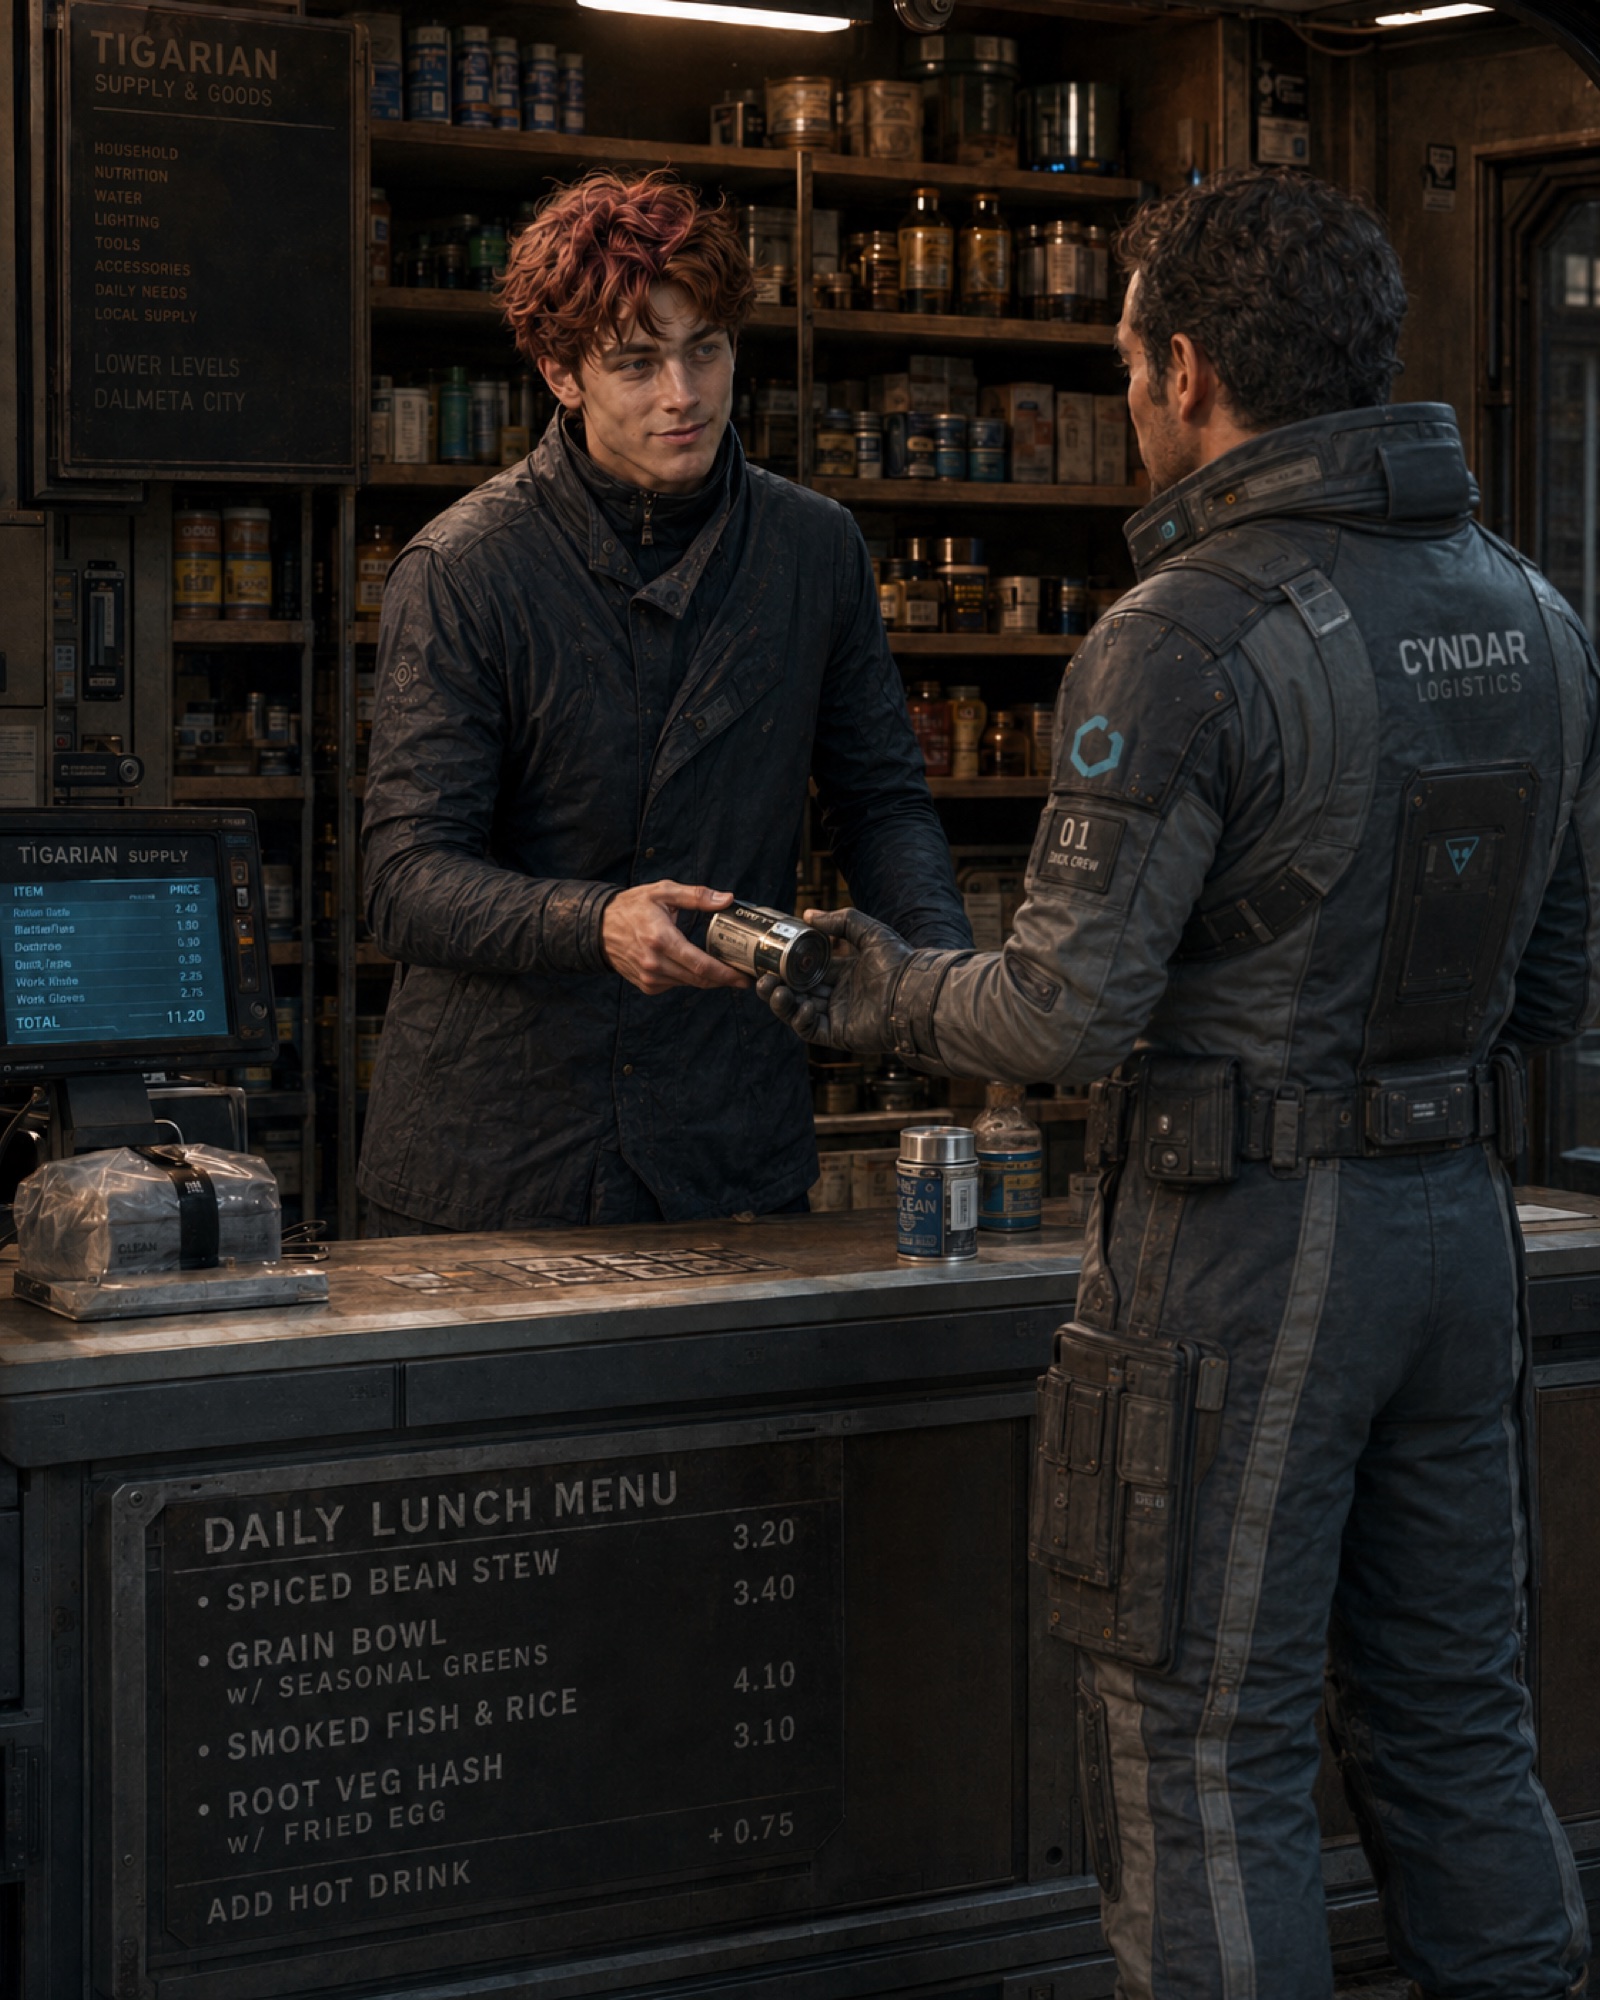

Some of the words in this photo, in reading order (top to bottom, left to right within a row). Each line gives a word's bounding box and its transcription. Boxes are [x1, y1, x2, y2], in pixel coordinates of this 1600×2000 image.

[91, 30, 278, 81] TIGARIAN
[95, 74, 175, 99] SUPPLY
[184, 84, 198, 100] &
[207, 84, 273, 107] GOODS
[95, 142, 179, 161] HOUSEHOLD
[95, 165, 169, 183] NUTRITION
[95, 189, 142, 205] WATER
[95, 213, 160, 229] LIGHTING
[95, 236, 141, 252] TOOLS
[95, 260, 191, 277] ACCESSORIES
[95, 284, 135, 299] DAILY
[142, 285, 188, 300] NEEDS
[95, 308, 139, 322] LOCAL
[145, 309, 197, 324] SUPPLY
[95, 354, 161, 375] LOWER
[171, 357, 240, 378] LEVELS
[95, 388, 194, 411] DALMETA
[204, 390, 246, 412] CITY
[1399, 630, 1530, 675] CYNDAR
[1416, 672, 1522, 702] LOGISTICS
[1060, 817, 1090, 850] 01
[18, 846, 117, 864] TIGARIAN
[129, 849, 189, 864] SUPPLY
[14, 886, 44, 897] ITEM
[169, 884, 200, 896] PRICE
[16, 1016, 60, 1029] TOTAL
[167, 1010, 206, 1023] 11.20
[205, 1505, 345, 1555] DAILY
[372, 1486, 532, 1537] LUNCH
[554, 1470, 678, 1517] MENU
[732, 1518, 795, 1551] 3.20
[226, 1571, 352, 1612] SPICED
[369, 1558, 457, 1596] BEAN
[472, 1548, 560, 1584] STEW
[732, 1574, 796, 1606] 3.40
[226, 1630, 335, 1671] GRAIN
[351, 1619, 448, 1656] BOWL
[227, 1678, 263, 1706] w/
[279, 1658, 431, 1700] SEASONAL
[444, 1644, 548, 1678] GREENS
[733, 1661, 796, 1693] 4.10
[227, 1716, 371, 1761] SMOKED
[386, 1703, 460, 1739] FISH
[474, 1700, 494, 1727] &
[506, 1687, 578, 1723] RICE
[733, 1715, 796, 1749] 3.10
[228, 1779, 321, 1819] ROOT
[336, 1768, 402, 1802] VEG
[418, 1752, 503, 1792] HASH
[227, 1826, 264, 1854] w/
[284, 1812, 373, 1845] FRIED
[388, 1800, 447, 1829] EGG
[709, 1826, 723, 1844] +
[734, 1811, 795, 1844] 0.75
[206, 1892, 273, 1925] ADD
[288, 1876, 354, 1911] HOT
[369, 1859, 472, 1899] DRINK
